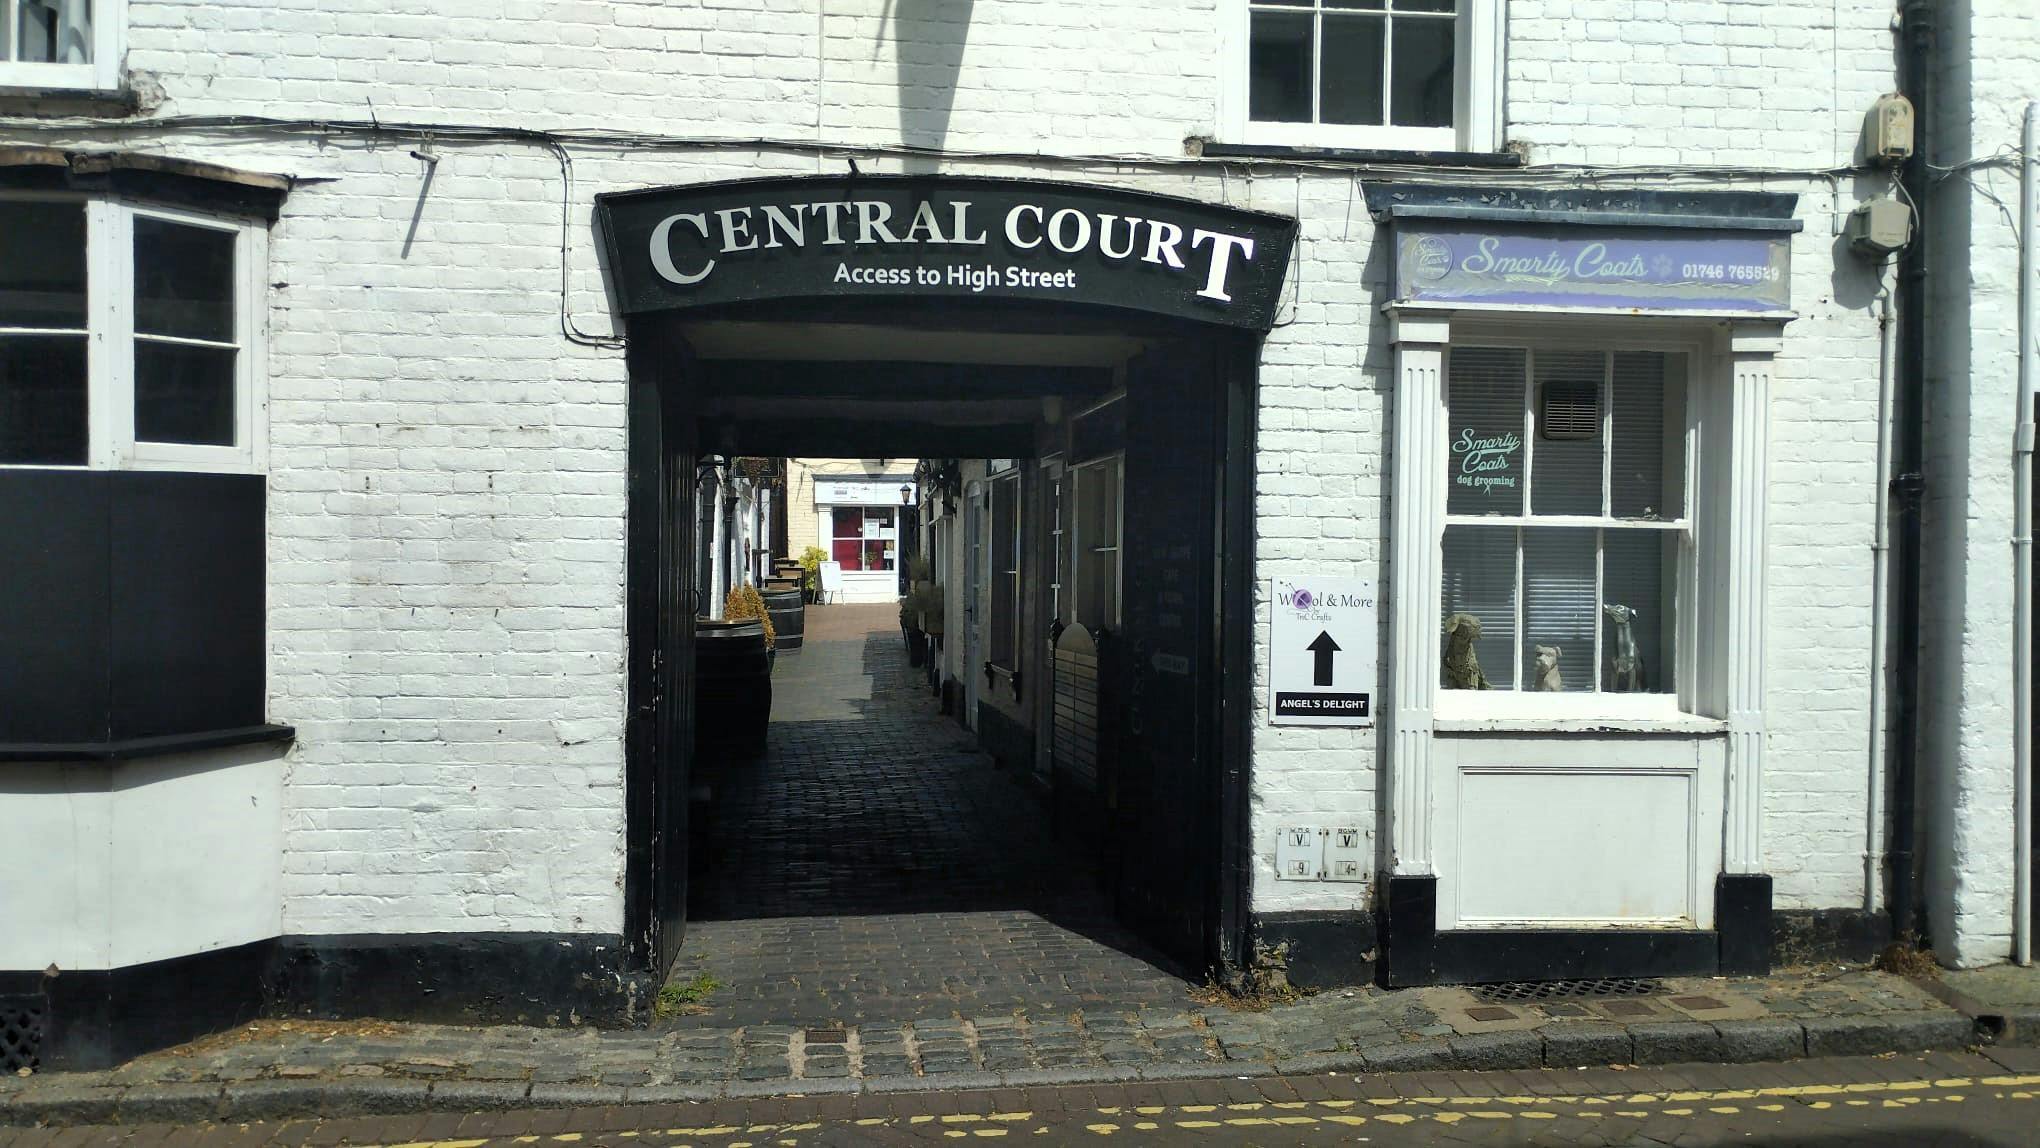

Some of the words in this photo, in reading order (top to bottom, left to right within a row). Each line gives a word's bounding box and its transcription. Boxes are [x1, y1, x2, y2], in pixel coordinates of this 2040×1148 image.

[649, 200, 987, 285] CENTRAL
[1004, 204, 1254, 303] COURT
[1461, 237, 1570, 284] Smarty
[1574, 243, 1648, 278] Coats
[1682, 264, 1724, 279] 01746
[833, 263, 911, 285] Access
[916, 266, 941, 285] to
[947, 265, 999, 292] High
[1004, 266, 1076, 289] Street
[1452, 428, 1520, 454] Smarty
[1462, 450, 1510, 473] Coats
[1456, 475, 1473, 486] dog
[1474, 475, 1515, 487] grooming
[1326, 593, 1337, 607] &
[1340, 593, 1373, 608] More
[1280, 698, 1320, 709] ANGEL'S
[1323, 699, 1366, 709] DELIGHT
[1295, 833, 1304, 846] V
[1343, 835, 1351, 847] V
